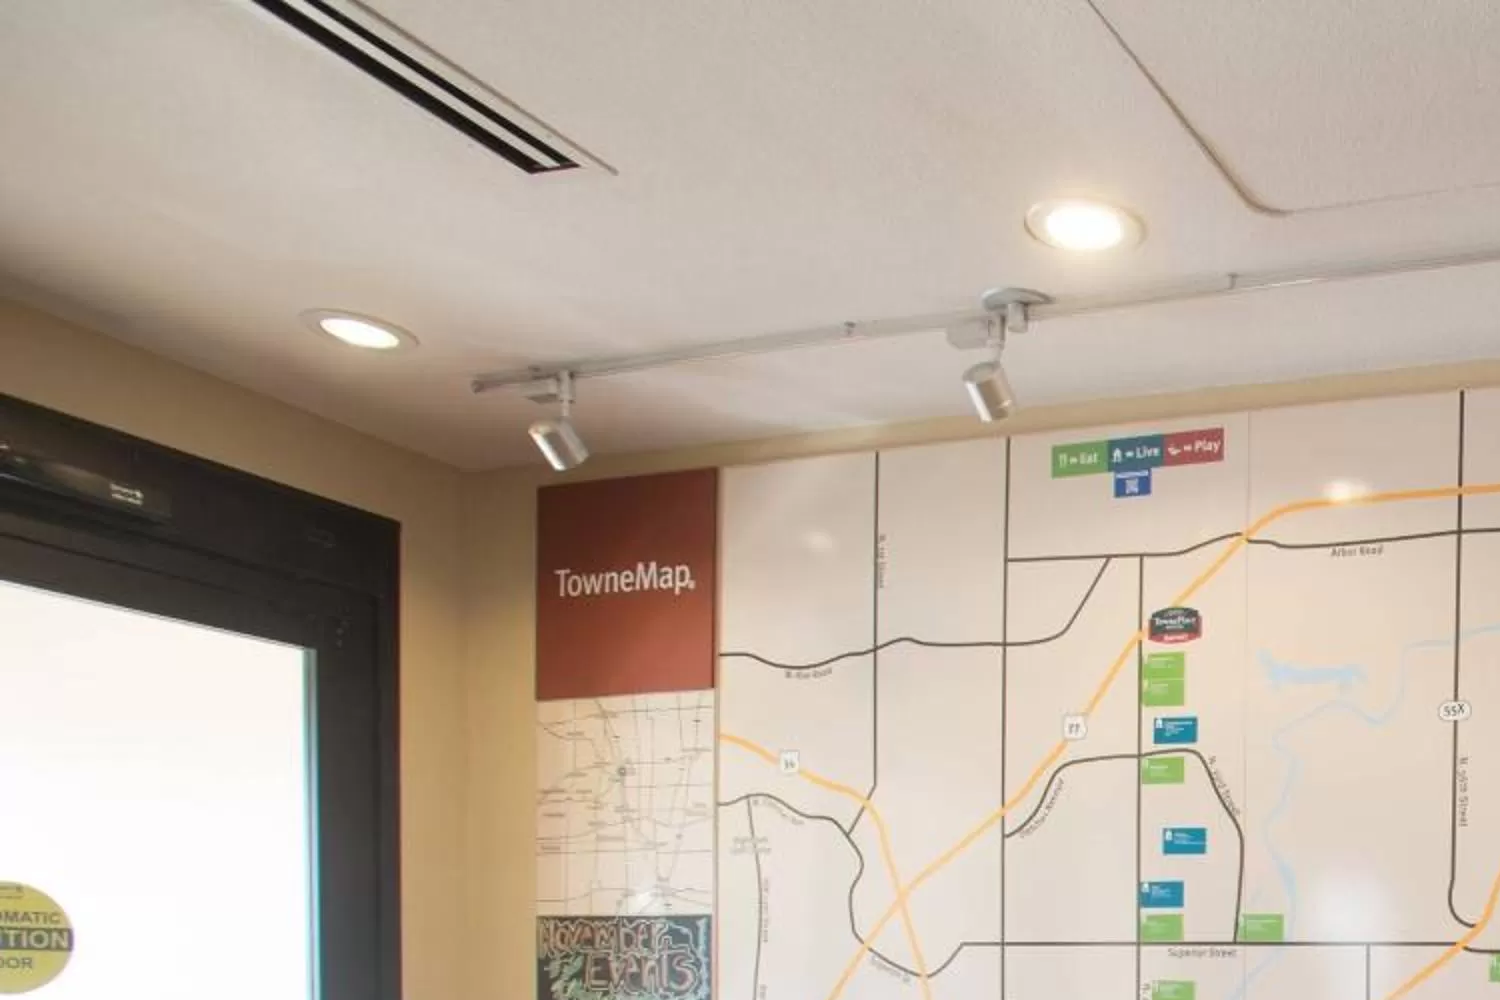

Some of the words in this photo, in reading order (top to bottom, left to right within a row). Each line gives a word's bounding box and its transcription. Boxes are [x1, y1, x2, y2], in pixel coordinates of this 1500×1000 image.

[1135, 445, 1160, 460] Live
[1193, 439, 1222, 455] Play
[1080, 452, 1099, 465] Eat
[1359, 545, 1384, 556] Road
[1459, 795, 1469, 828] Street
[0, 911, 62, 925] MATIC
[0, 929, 69, 949] TION
[1208, 947, 1238, 958] Street
[585, 938, 699, 995] Events
